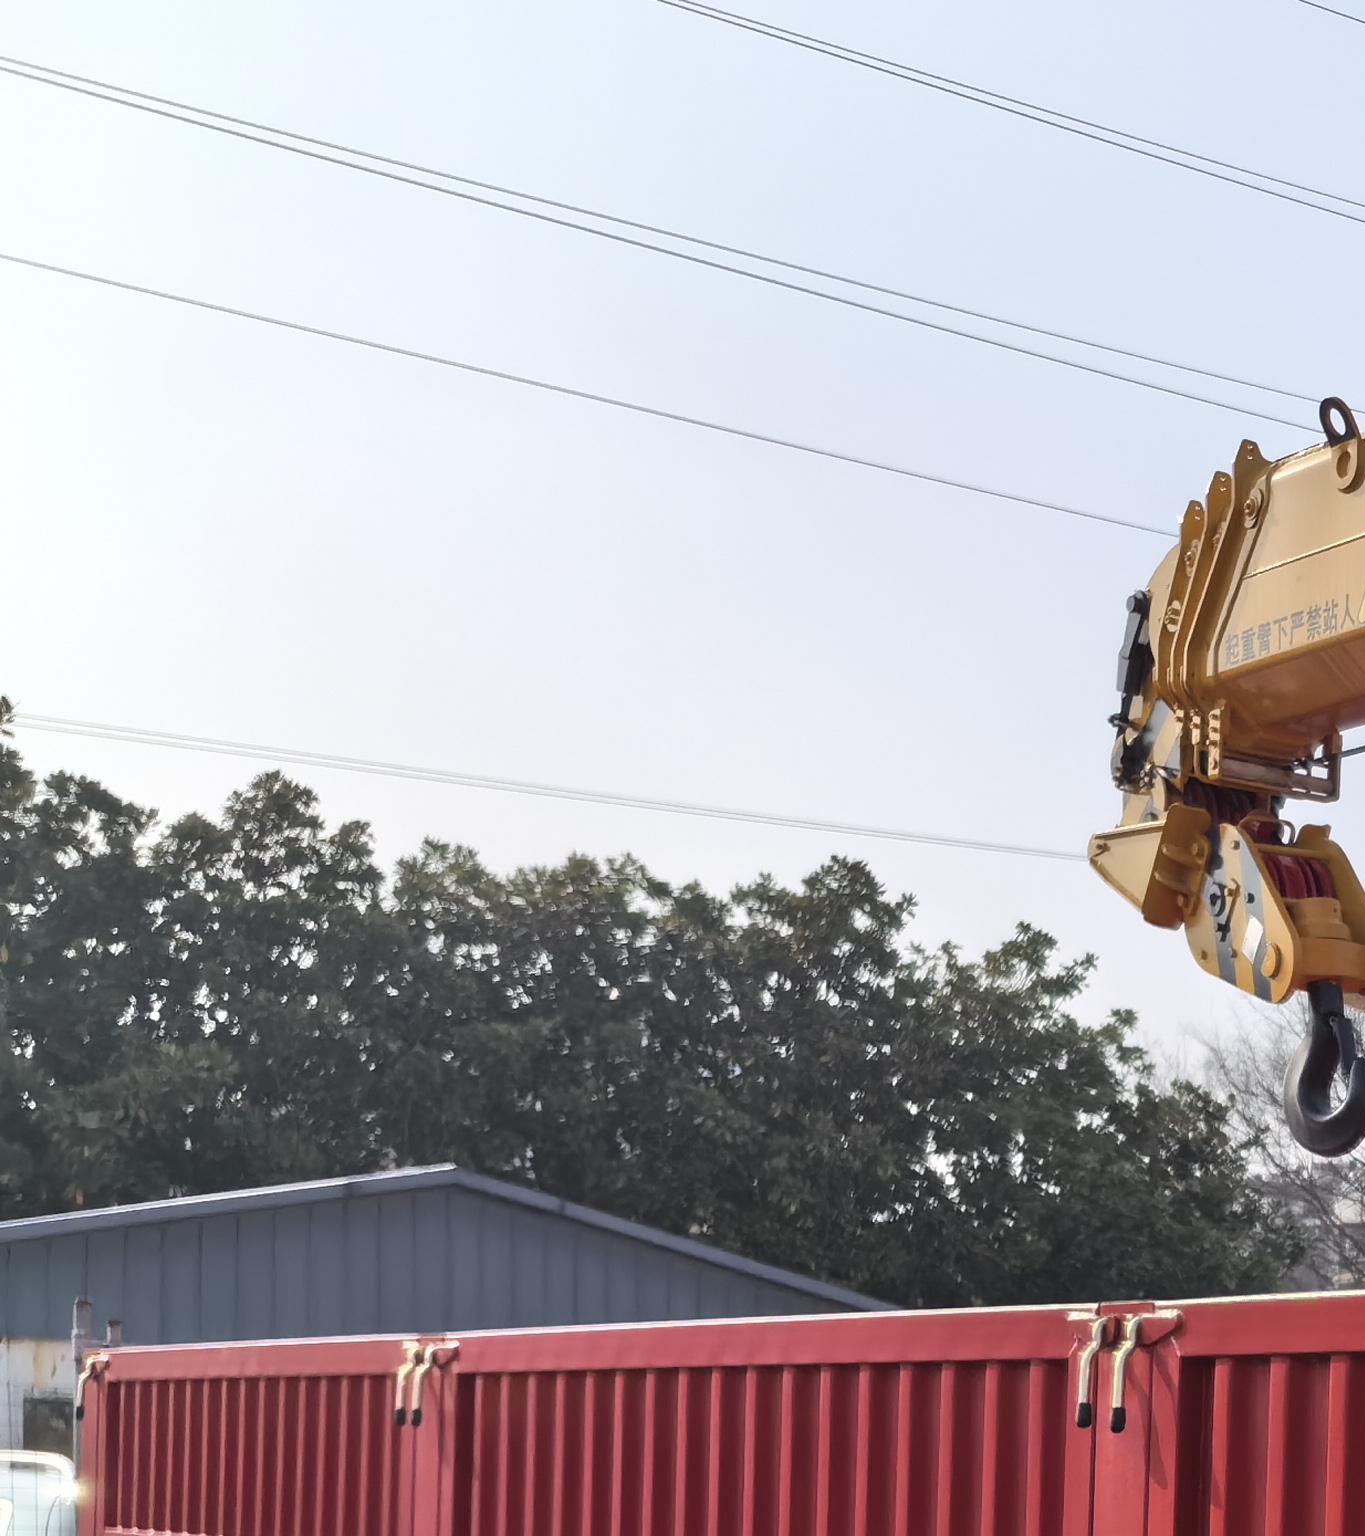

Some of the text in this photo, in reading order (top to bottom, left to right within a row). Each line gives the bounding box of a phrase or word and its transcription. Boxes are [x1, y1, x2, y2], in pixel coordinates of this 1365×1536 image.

[1224, 593, 1356, 667] 起重臂下严禁站人
